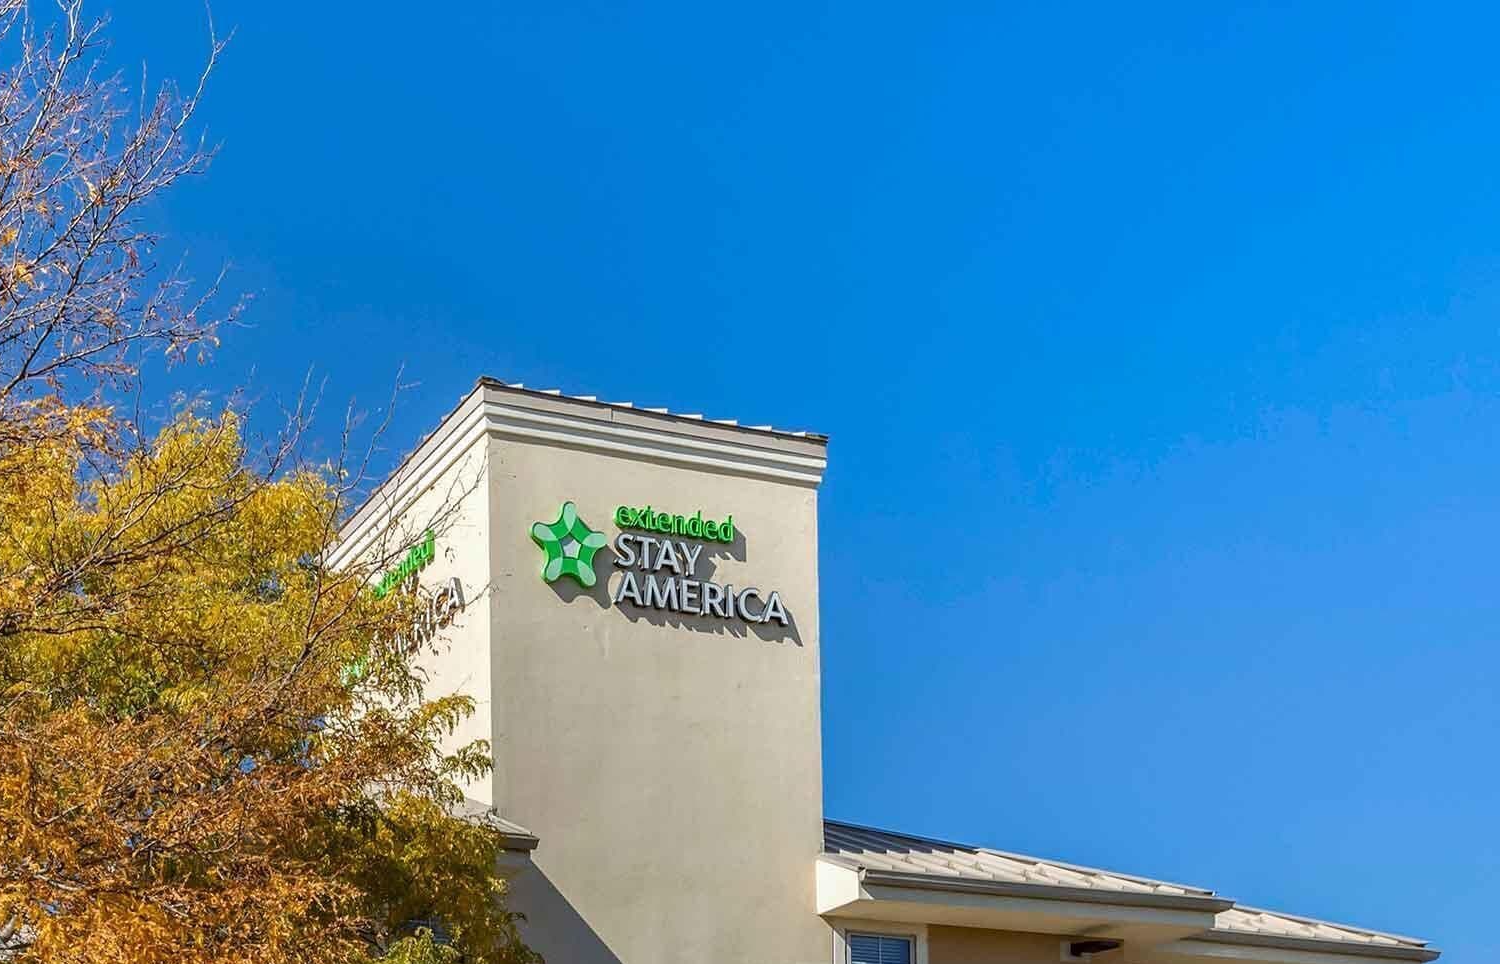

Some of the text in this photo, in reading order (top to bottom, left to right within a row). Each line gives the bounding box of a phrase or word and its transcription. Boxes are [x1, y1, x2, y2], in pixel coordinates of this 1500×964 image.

[613, 506, 735, 543] extended
[613, 533, 703, 576] STAY
[612, 571, 789, 625] AMERICA
